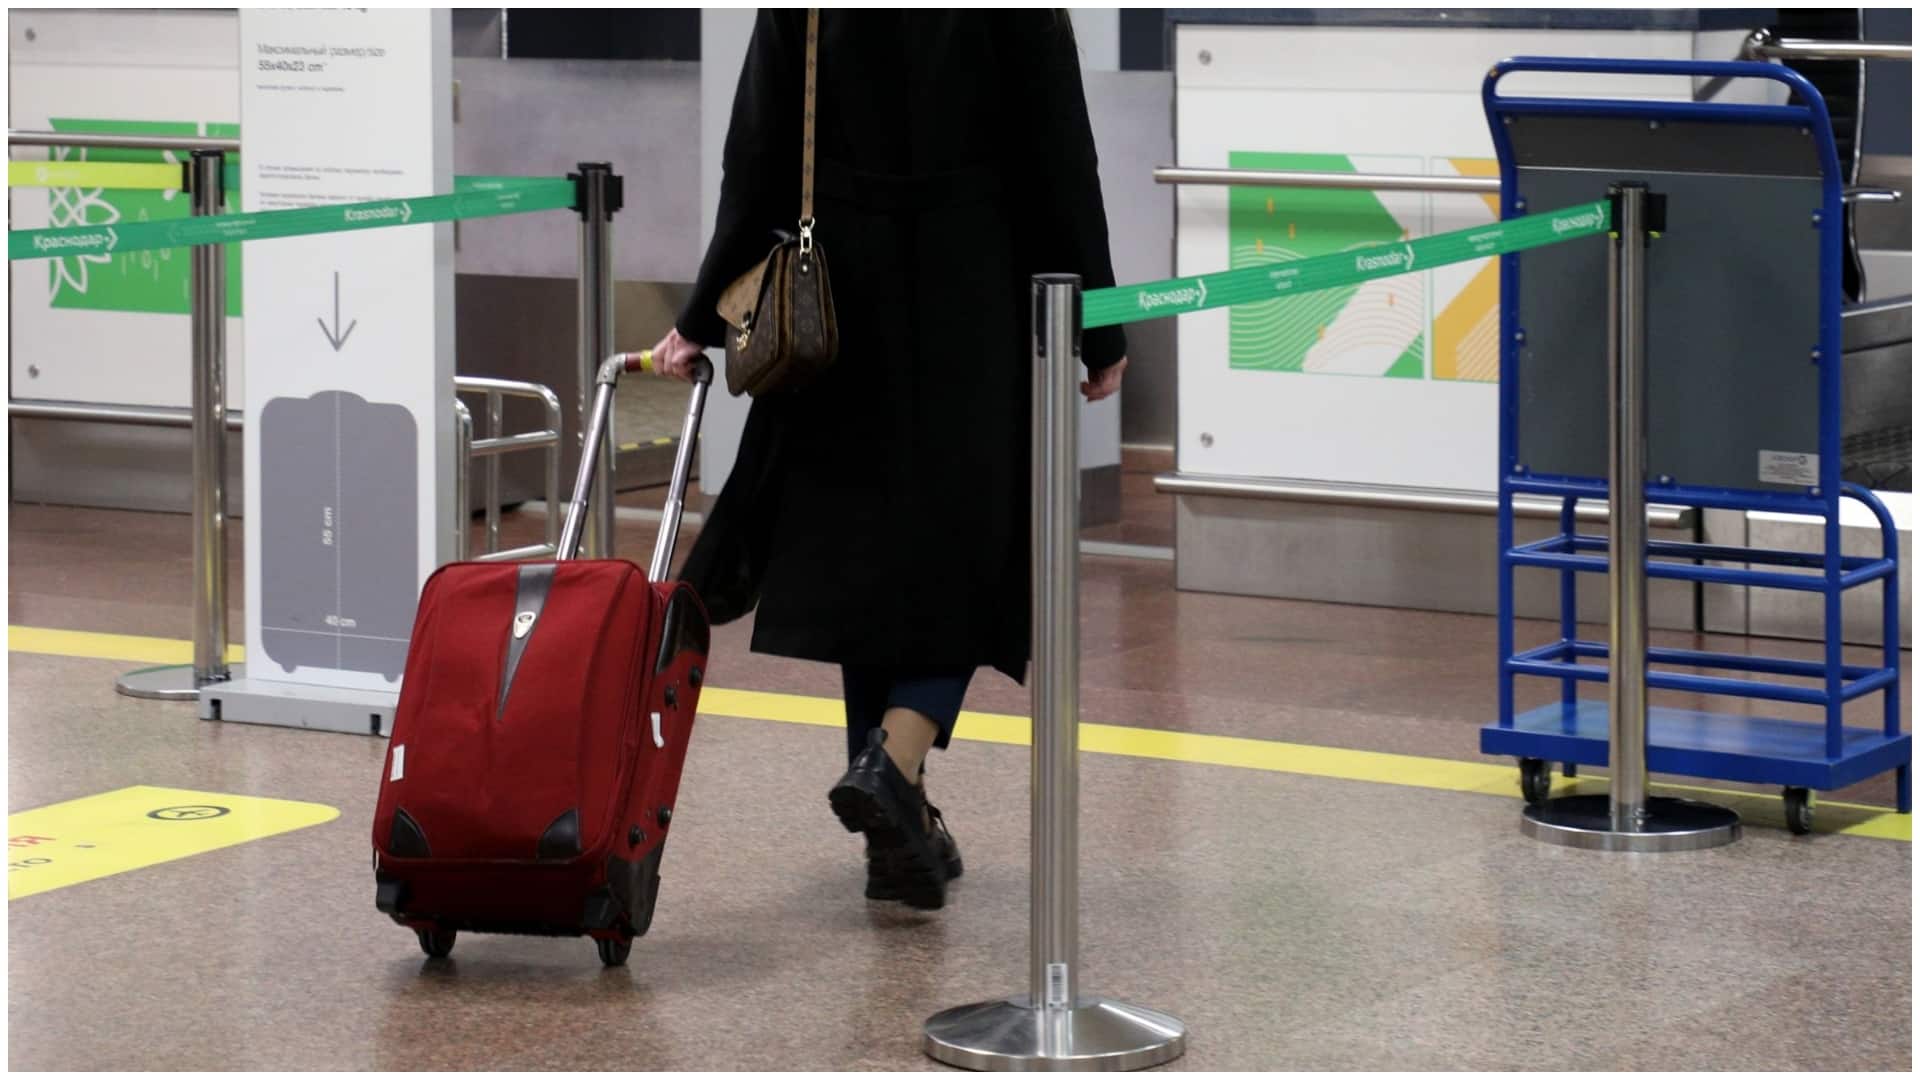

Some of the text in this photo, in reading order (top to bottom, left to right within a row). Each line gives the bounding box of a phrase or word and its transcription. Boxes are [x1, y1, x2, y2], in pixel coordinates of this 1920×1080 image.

[344, 205, 399, 222] Krasnodar
[1552, 212, 1595, 235] Краснодар
[33, 234, 103, 251] Краснодар
[1356, 252, 1402, 271] Krasnodar
[1138, 286, 1196, 311] Краснодар
[322, 529, 333, 545] 55
[325, 615, 339, 626] 40
